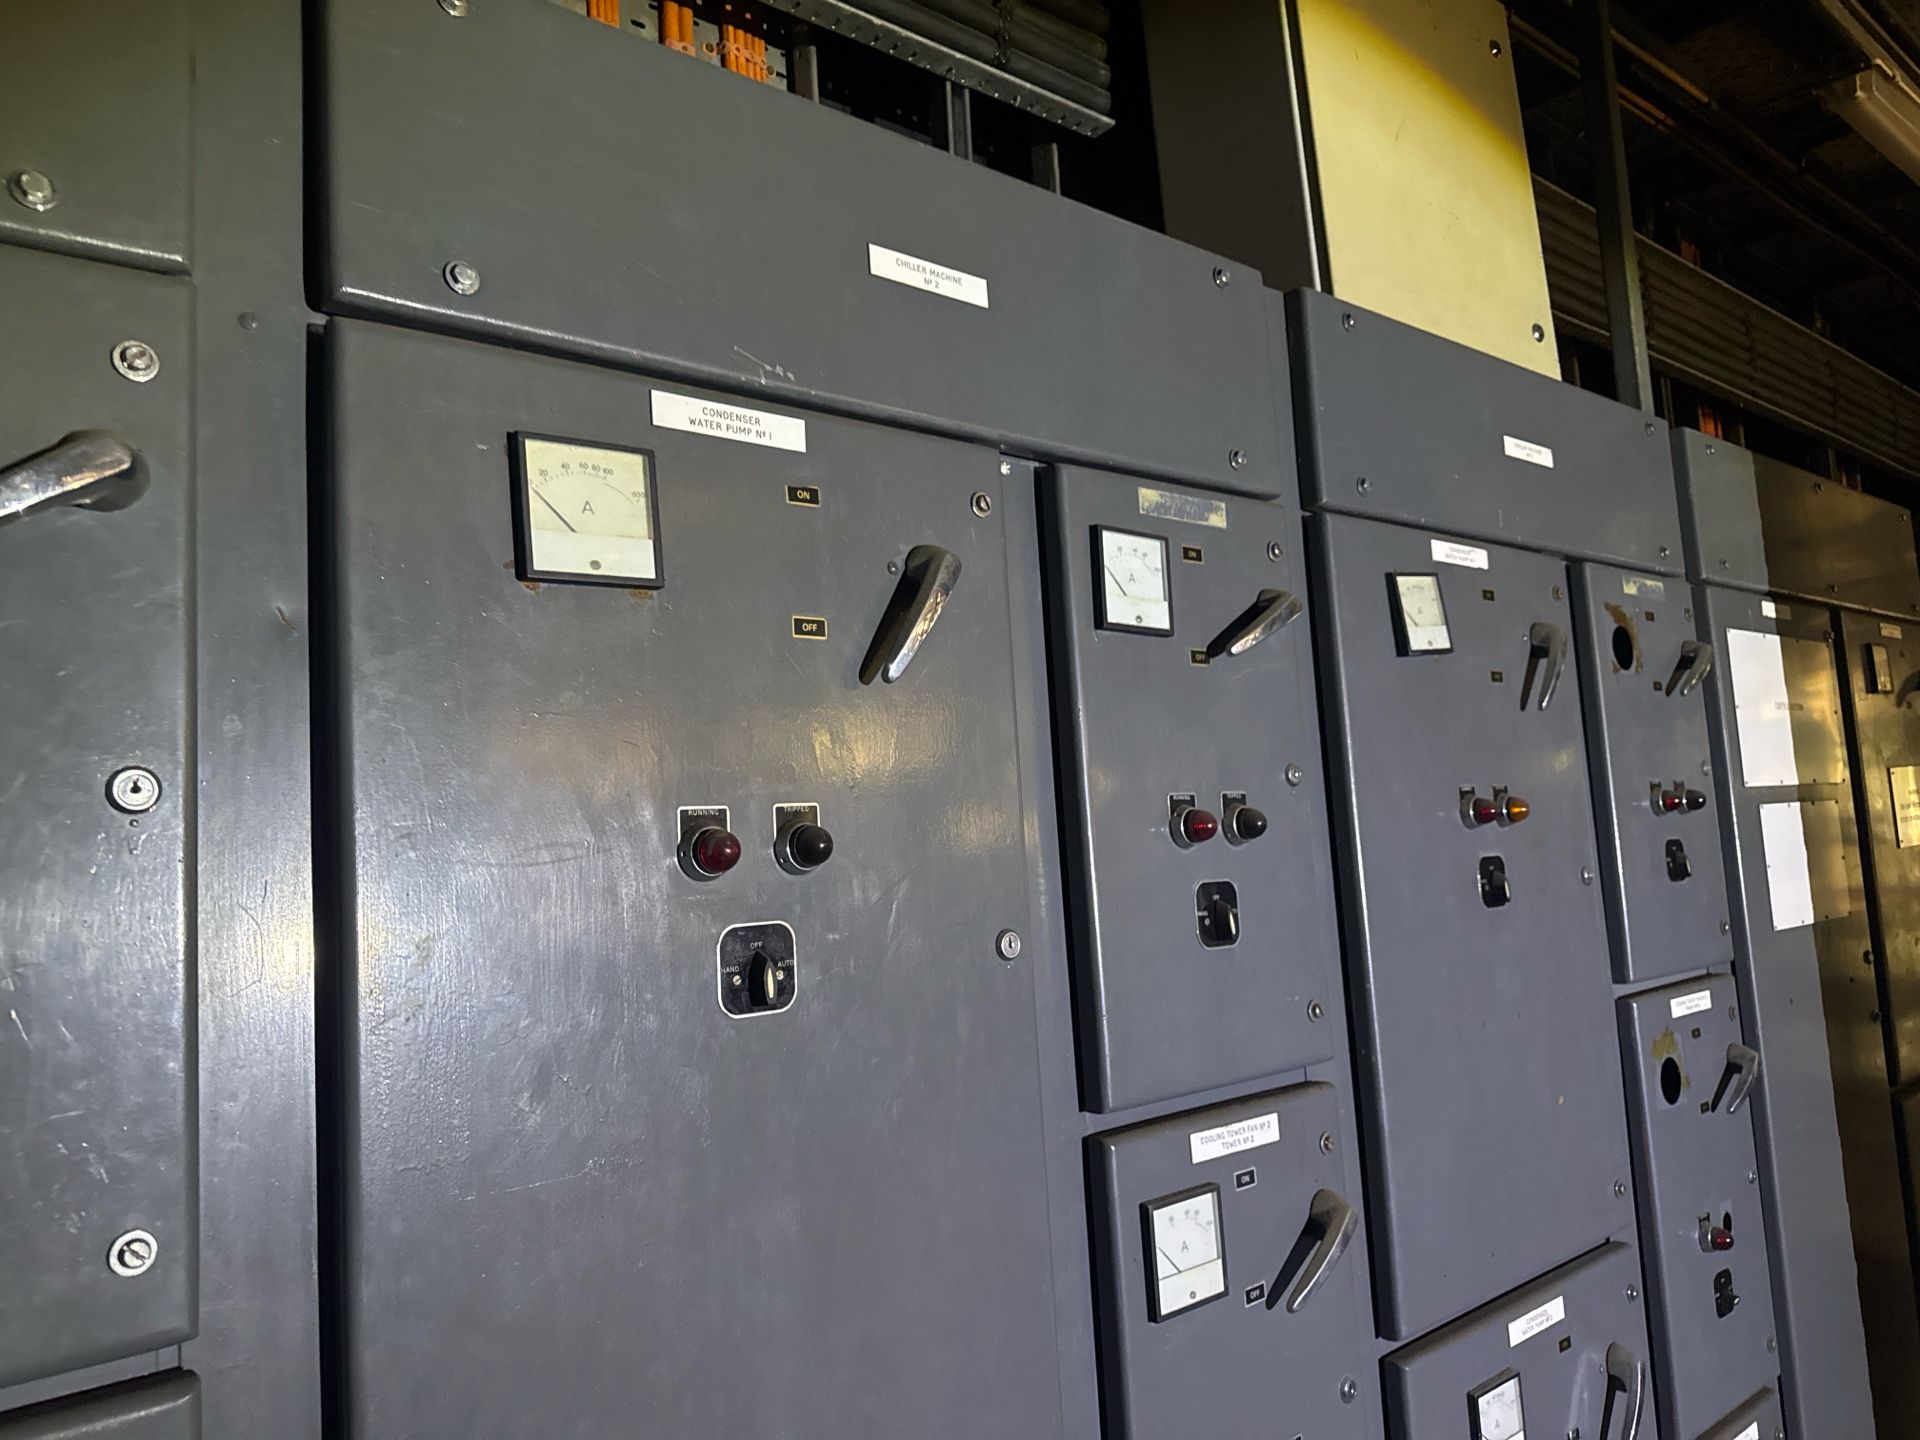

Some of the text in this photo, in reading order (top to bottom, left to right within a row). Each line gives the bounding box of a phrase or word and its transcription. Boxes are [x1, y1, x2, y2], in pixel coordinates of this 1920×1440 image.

[895, 257, 962, 286] CHILLER MACHINE
[934, 281, 940, 289] 2
[702, 406, 761, 427] CONDENSER
[688, 416, 722, 431] WATER
[726, 423, 752, 437] PUMP
[560, 461, 570, 470] 40
[579, 461, 589, 470] 60
[602, 466, 614, 475] 100
[797, 490, 810, 500] ON
[582, 500, 595, 515] A
[802, 622, 818, 632] OFF
[687, 808, 720, 817] RUNNING
[750, 941, 763, 950] OFF
[777, 959, 795, 968] AUTO
[1200, 1131, 1226, 1145] COOLING
[1226, 1125, 1246, 1138] TOWER
[1221, 1139, 1241, 1150] TOWER
[1241, 1175, 1250, 1184] ON
